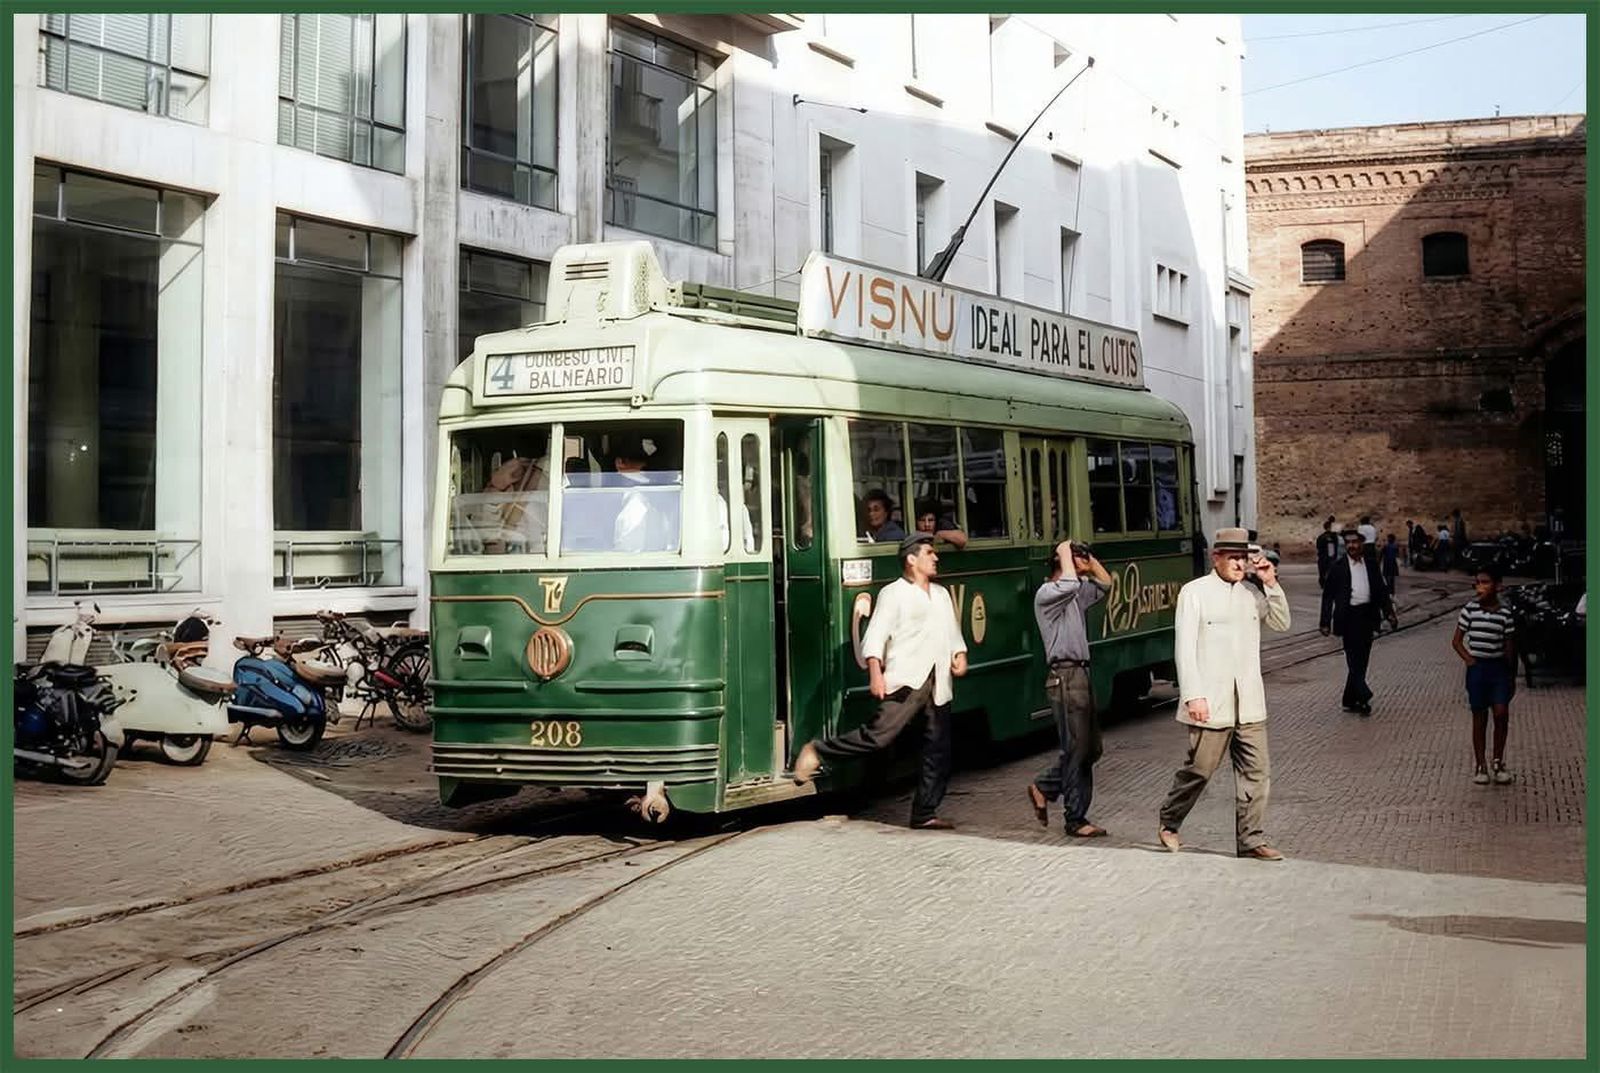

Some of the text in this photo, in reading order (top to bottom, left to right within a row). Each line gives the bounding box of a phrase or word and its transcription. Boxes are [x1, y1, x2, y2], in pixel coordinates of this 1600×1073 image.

[826, 266, 1138, 377] VISNU IDEAL PARA EL CUTIS
[491, 355, 515, 390] 4
[529, 366, 624, 389] BALNEARIO
[531, 720, 582, 747] 208
